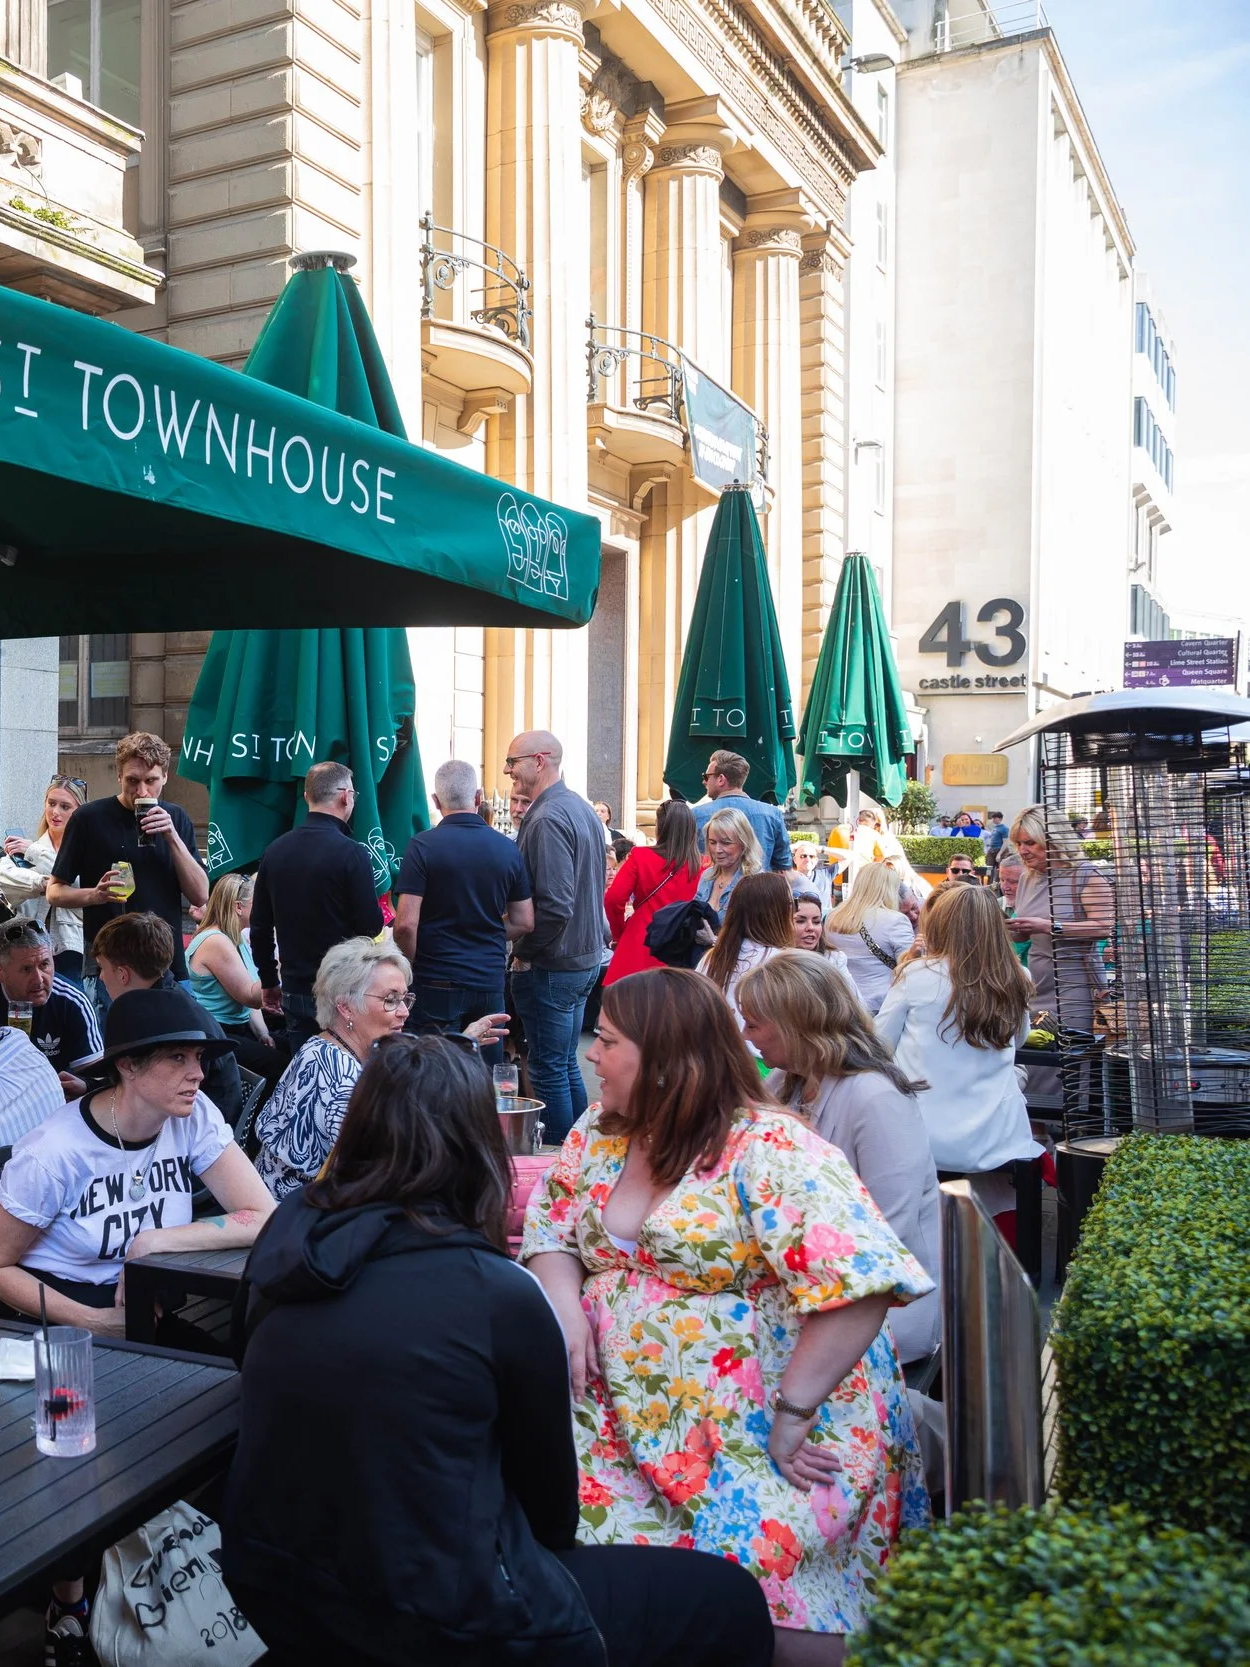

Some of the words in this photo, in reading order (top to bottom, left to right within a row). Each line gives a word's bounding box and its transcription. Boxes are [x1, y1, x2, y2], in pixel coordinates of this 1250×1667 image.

[73, 359, 397, 525] TOWNHOUSE
[918, 598, 1027, 668] 43
[1180, 640, 1202, 648] Cavern
[1203, 639, 1229, 647] Quarter
[1177, 649, 1202, 657] Cultural
[1203, 648, 1229, 656] Quarter
[918, 673, 971, 690] castle
[974, 673, 1027, 689] street
[1181, 669, 1203, 677] Queen
[1204, 668, 1228, 676] Square
[1190, 678, 1227, 686] Metquarter
[69, 1172, 125, 1220] NEW
[97, 1197, 166, 1261] CITY
[200, 1606, 249, 1648] 2018
